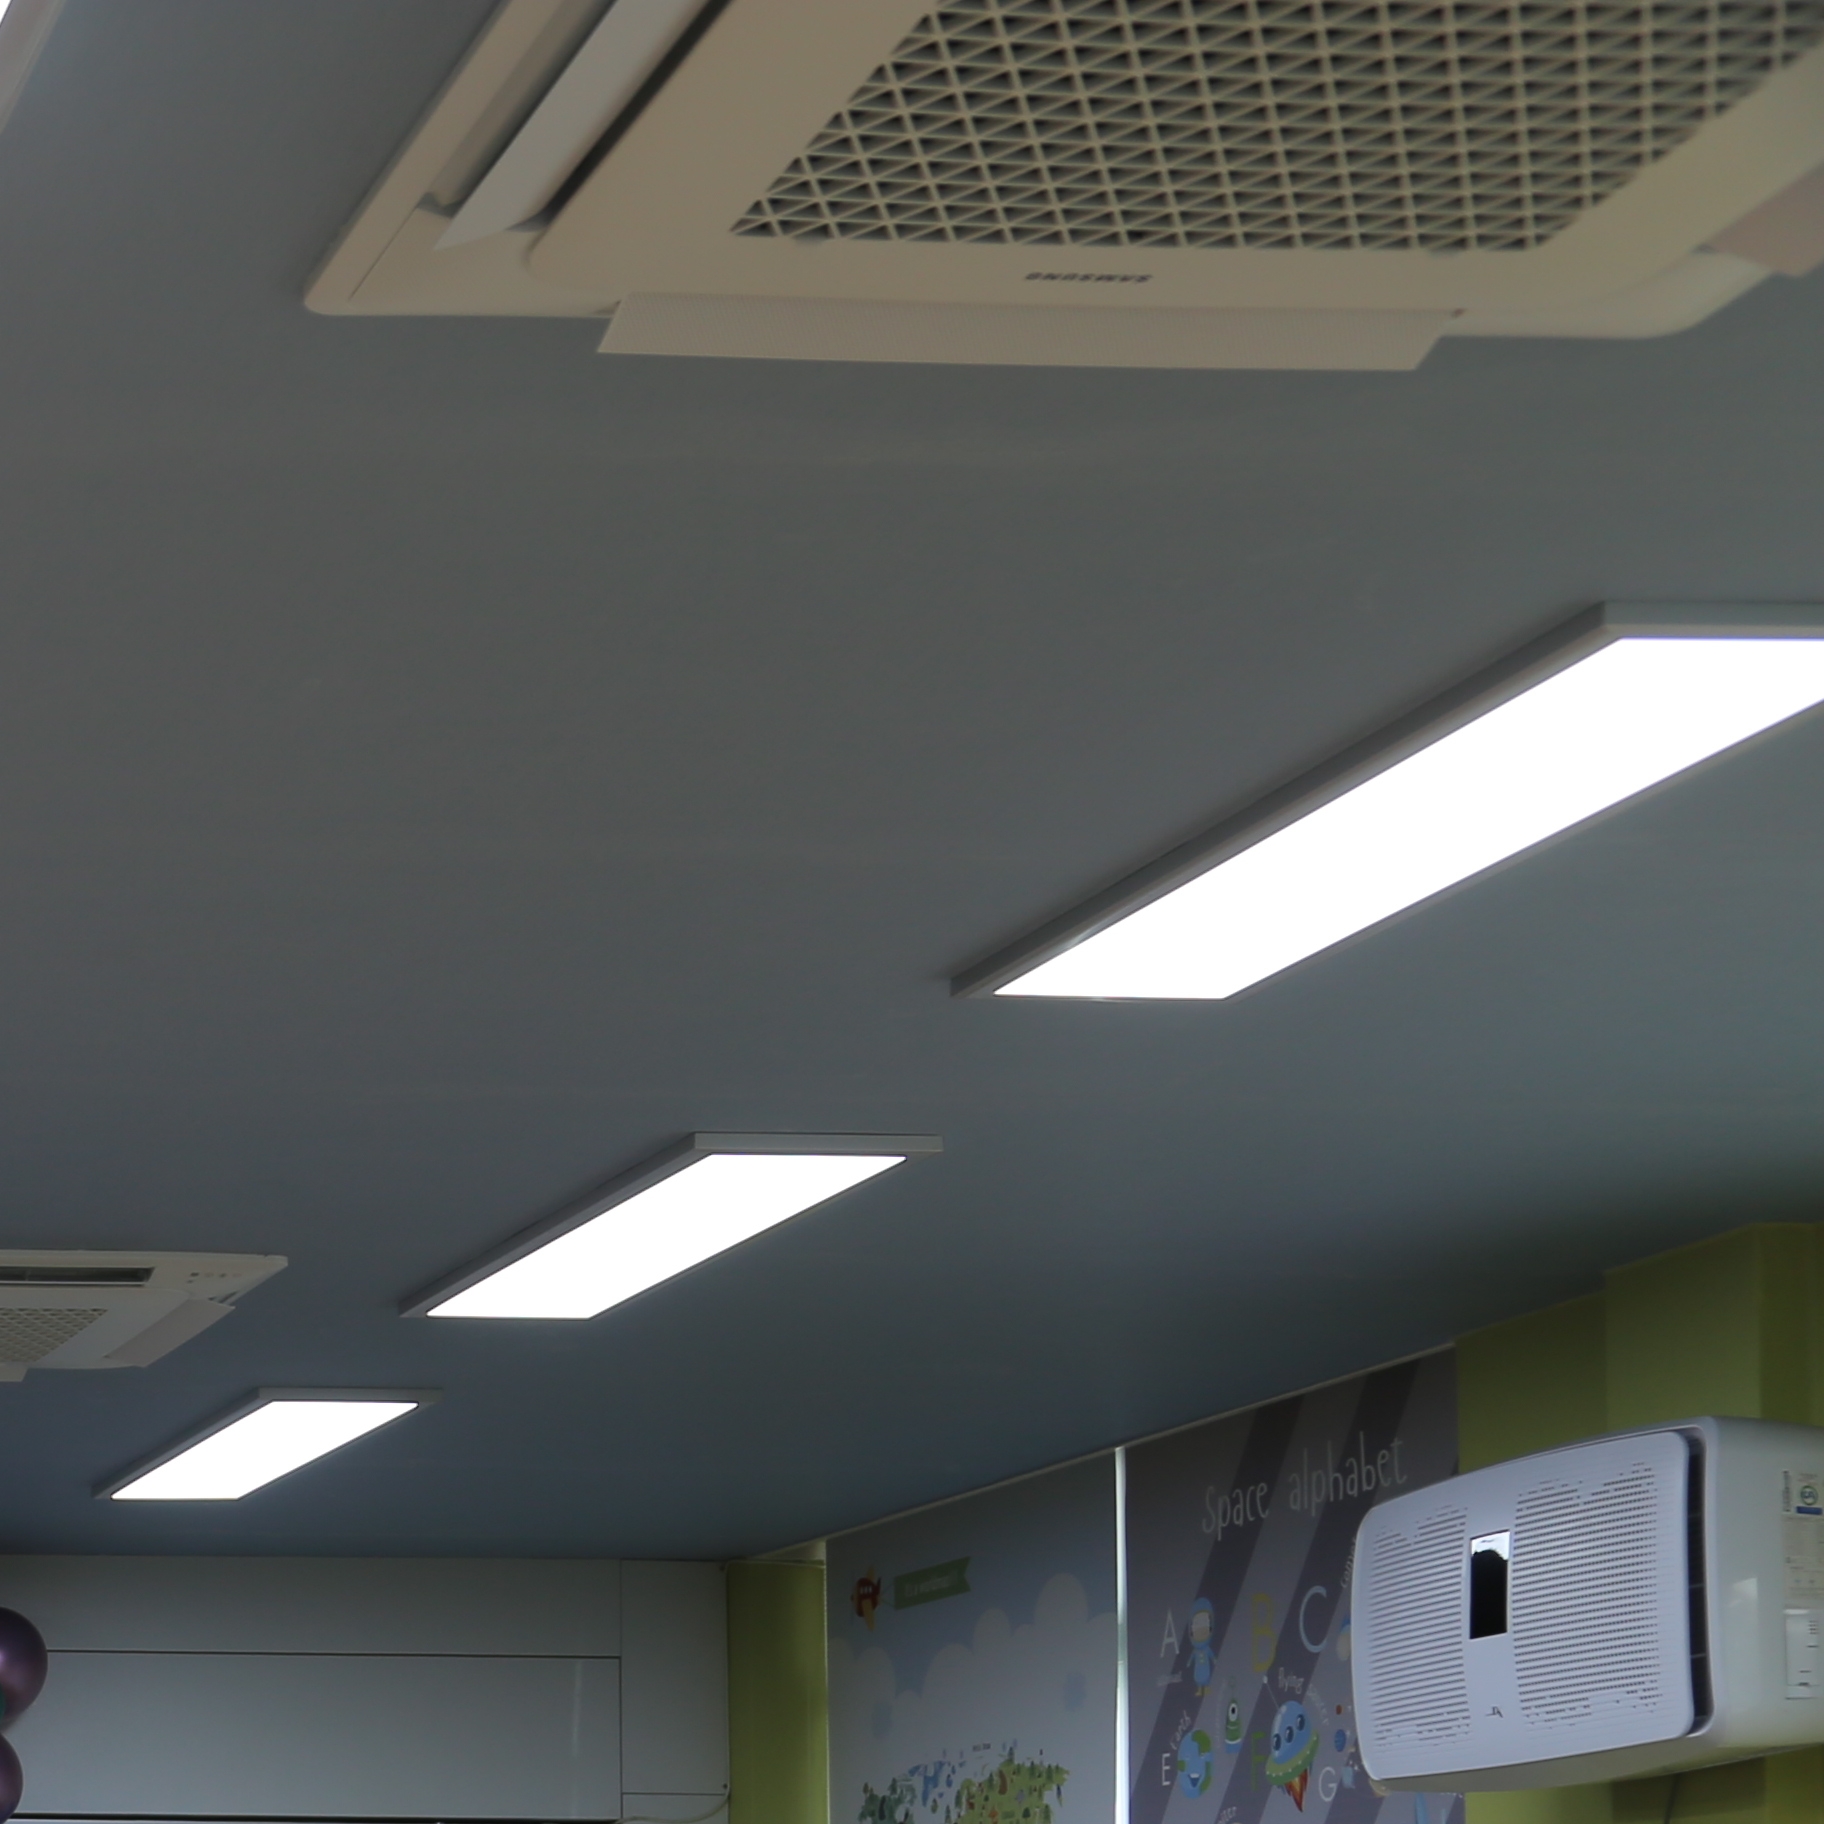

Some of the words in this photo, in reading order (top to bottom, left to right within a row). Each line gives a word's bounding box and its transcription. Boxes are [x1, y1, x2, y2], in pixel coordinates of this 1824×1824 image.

[1202, 1483, 1269, 1541] Space
[1288, 1431, 1407, 1518] alphabet
[1160, 1610, 1180, 1658] A
[1254, 1592, 1276, 1674] B
[1298, 1584, 1328, 1653] C
[1161, 1753, 1171, 1786] E
[1318, 1766, 1338, 1801] G
